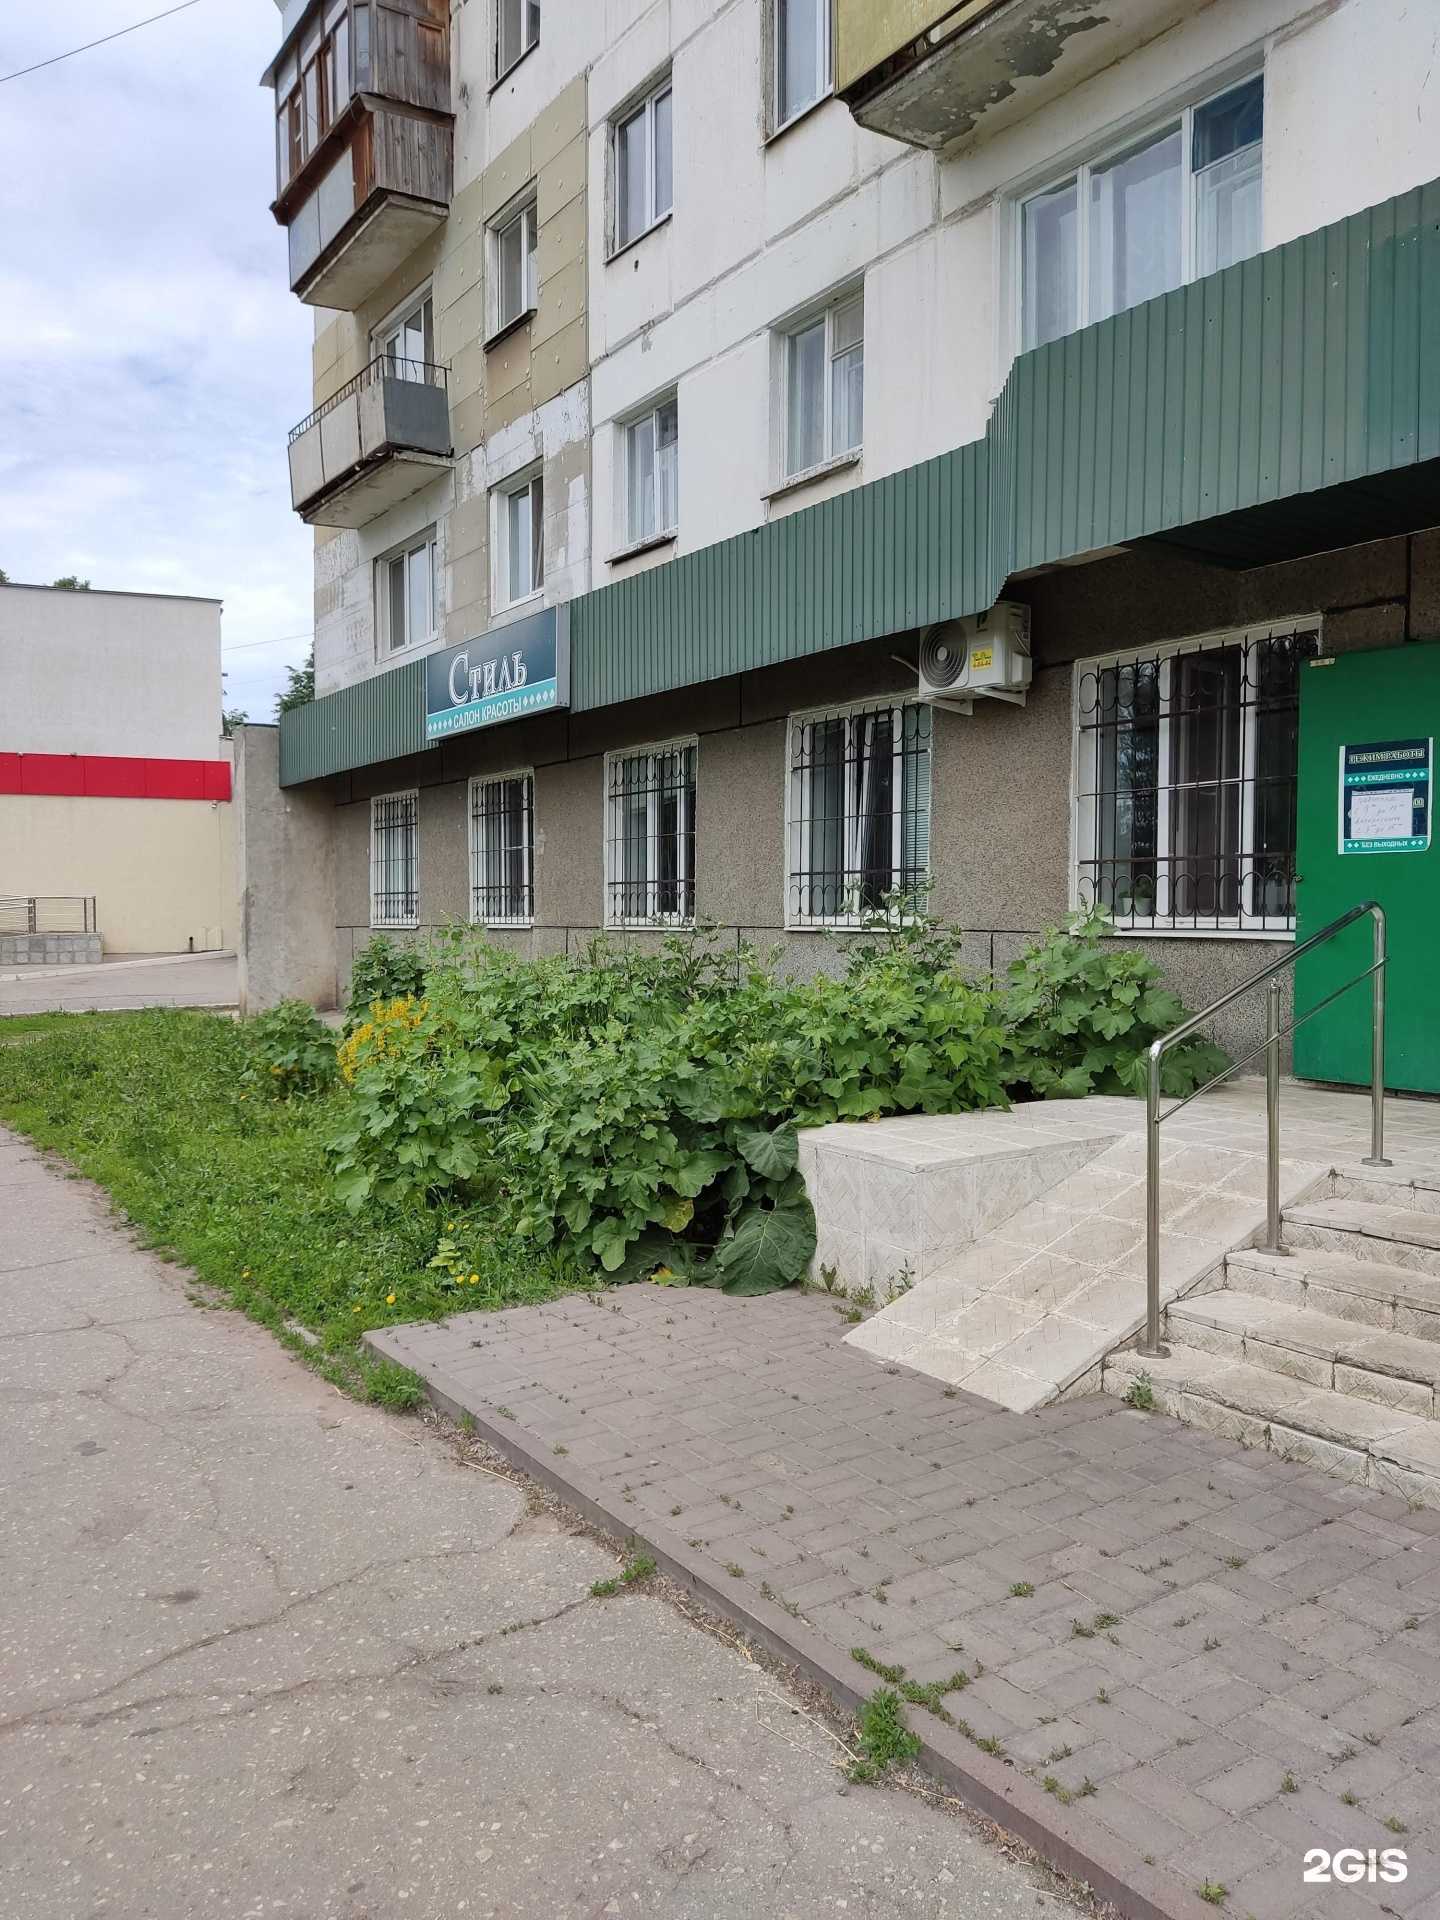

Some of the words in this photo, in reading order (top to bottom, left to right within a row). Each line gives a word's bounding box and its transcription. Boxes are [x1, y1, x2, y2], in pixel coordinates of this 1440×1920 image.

[453, 711, 480, 729] САЛОН
[481, 698, 522, 721] КРАСОТЫ
[1384, 748, 1425, 761] РАБОТЫ
